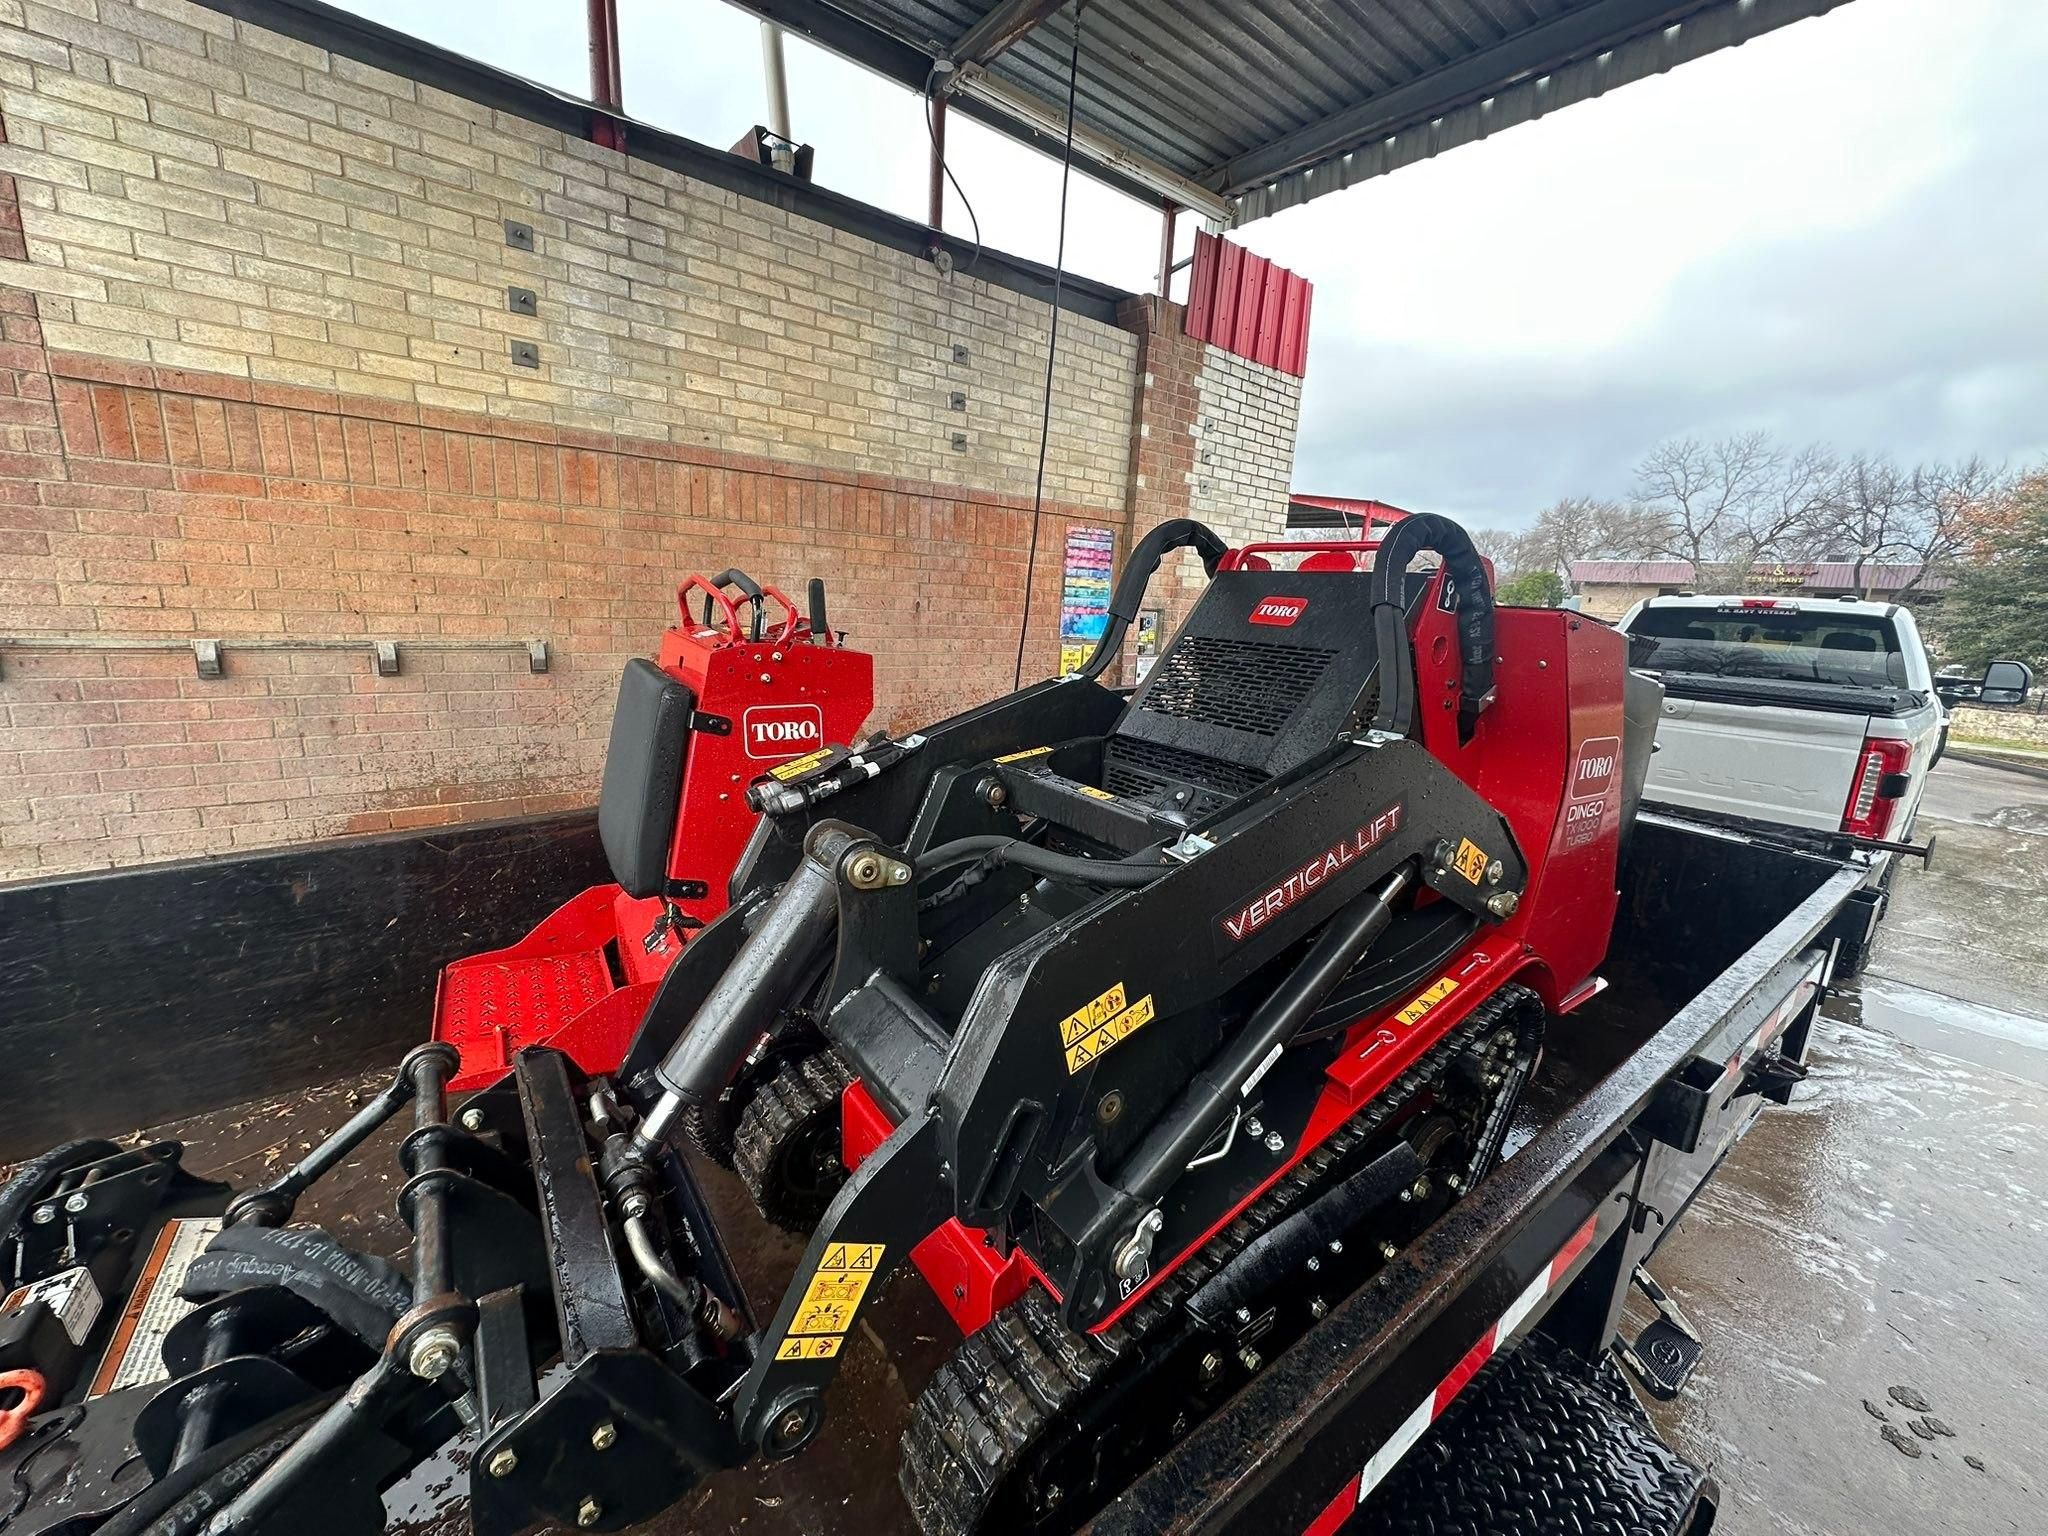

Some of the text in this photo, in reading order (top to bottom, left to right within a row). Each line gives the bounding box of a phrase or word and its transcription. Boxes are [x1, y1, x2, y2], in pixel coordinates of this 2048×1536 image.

[1258, 604, 1299, 618] TORO
[1578, 755, 1612, 780] TORO
[1567, 800, 1604, 822] DINGO
[1567, 831, 1593, 846] TURBO
[1224, 804, 1401, 939] VERTICAL LIFT
[226, 1251, 299, 1286] Aeroquip
[131, 1276, 155, 1311] WARNING
